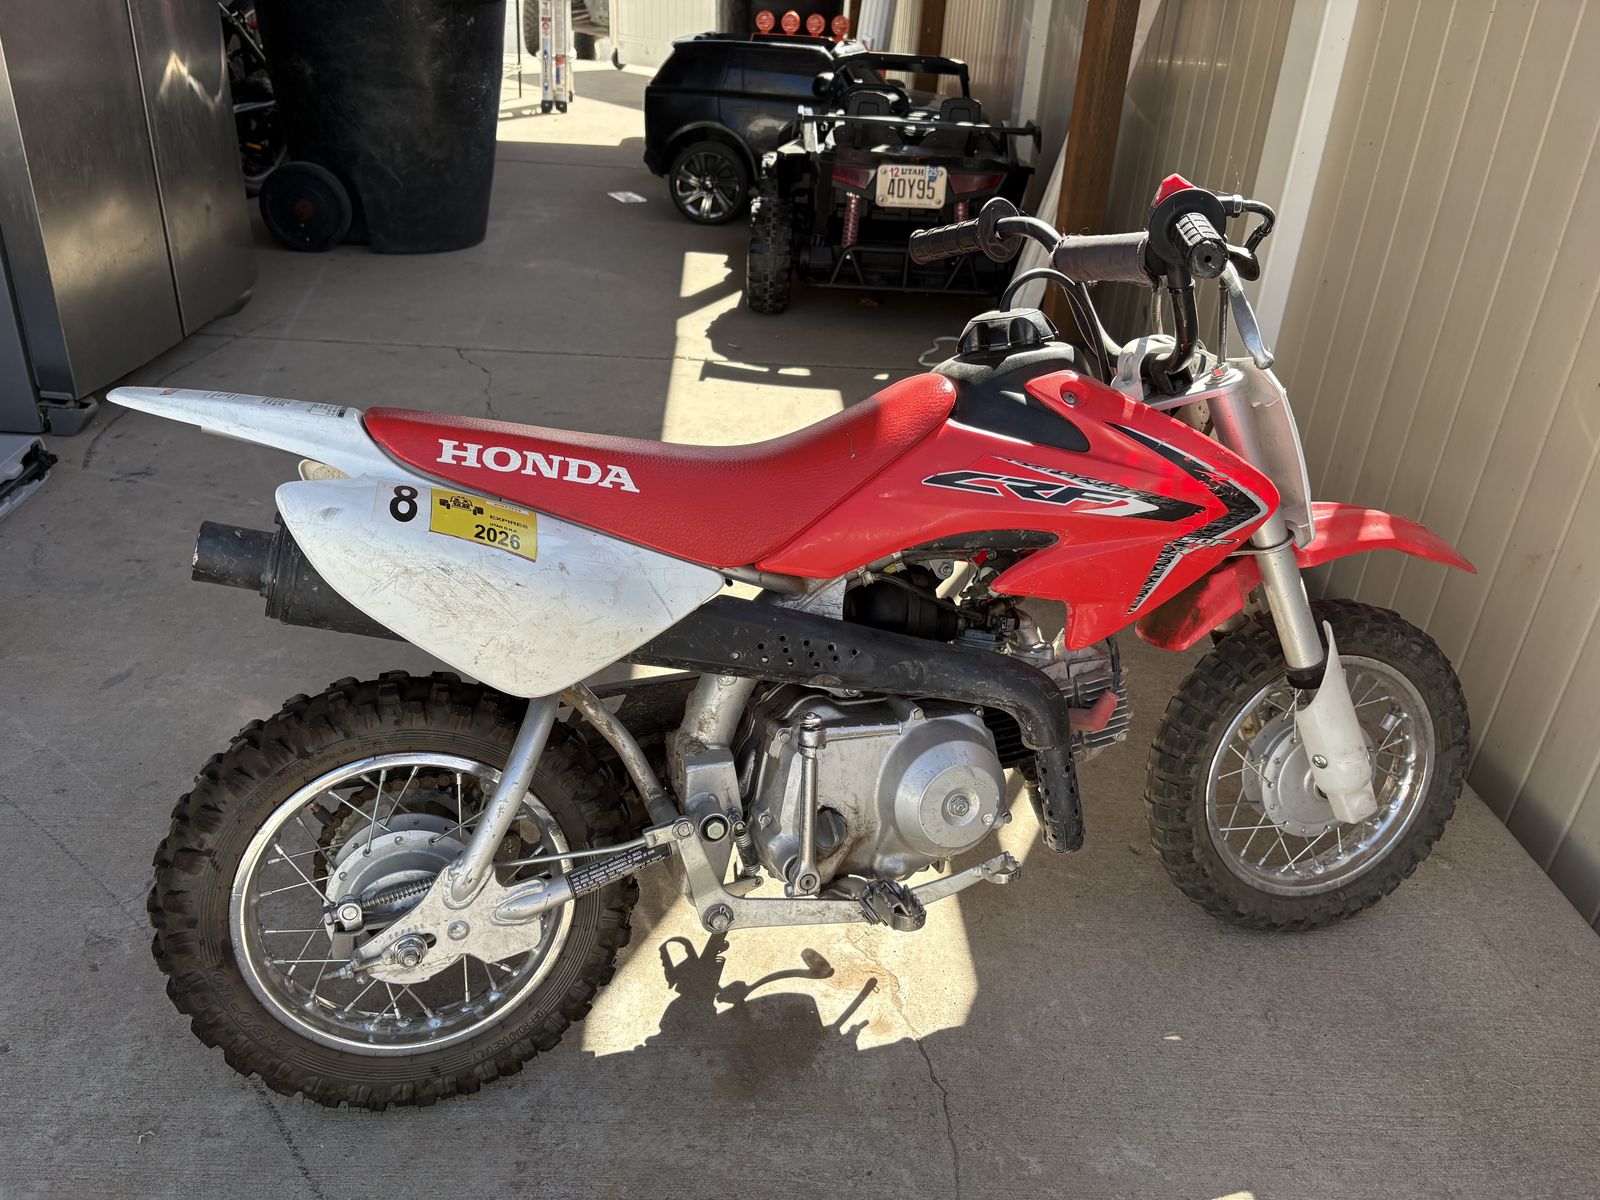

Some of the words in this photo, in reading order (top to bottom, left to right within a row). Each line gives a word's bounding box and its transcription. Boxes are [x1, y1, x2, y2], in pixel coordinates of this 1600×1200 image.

[890, 167, 899, 177] 12
[901, 168, 924, 176] UTAH
[436, 438, 640, 493] HONDA
[389, 485, 418, 523] 8
[922, 470, 1140, 507] CRF
[474, 524, 520, 550] 2026
[490, 515, 529, 529] EXPIRES
